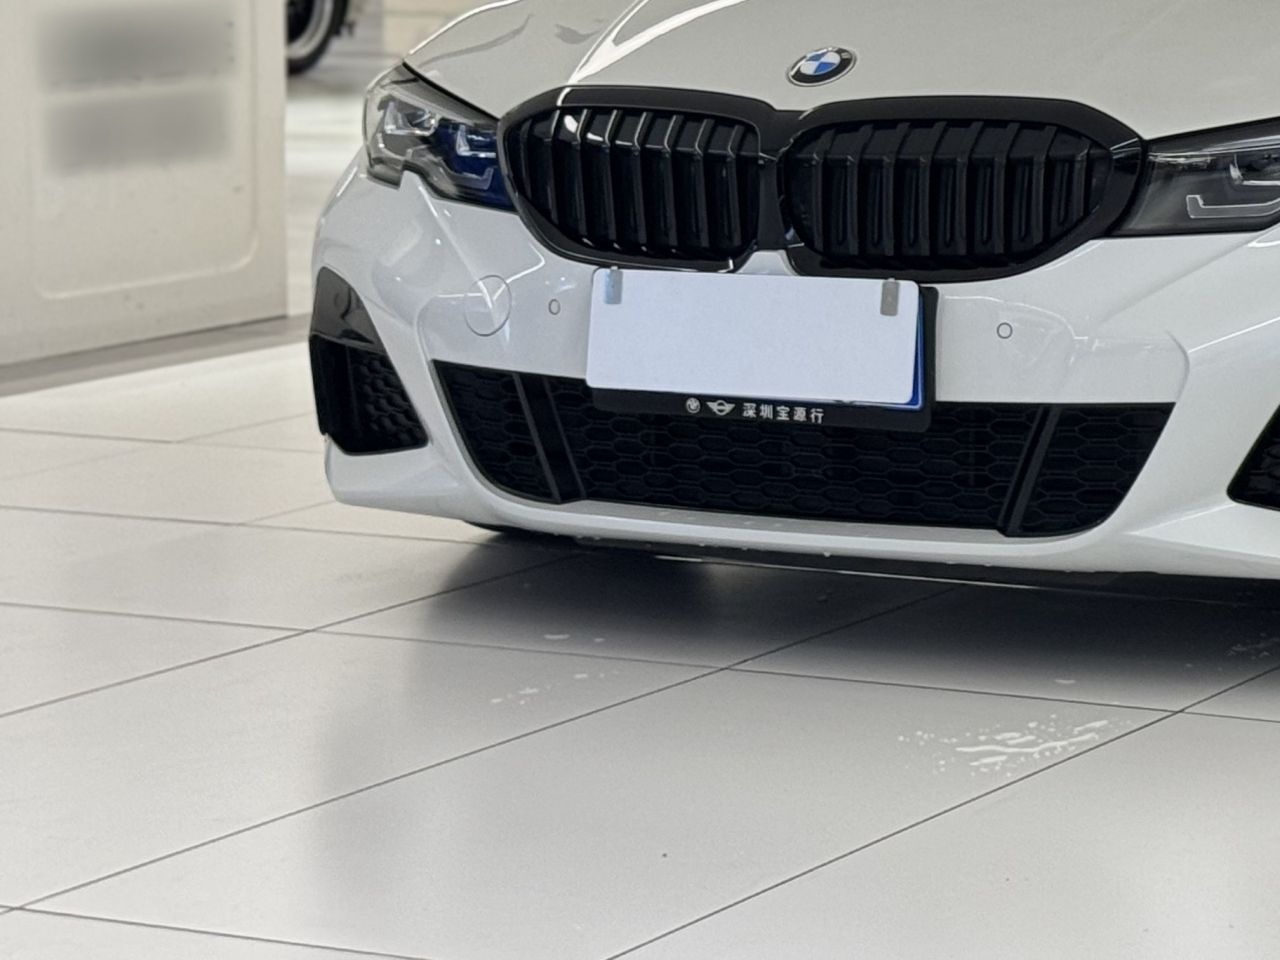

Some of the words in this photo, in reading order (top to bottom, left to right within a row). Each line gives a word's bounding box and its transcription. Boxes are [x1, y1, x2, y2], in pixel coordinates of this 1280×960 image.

[742, 402, 824, 424] 深圳宝源行
